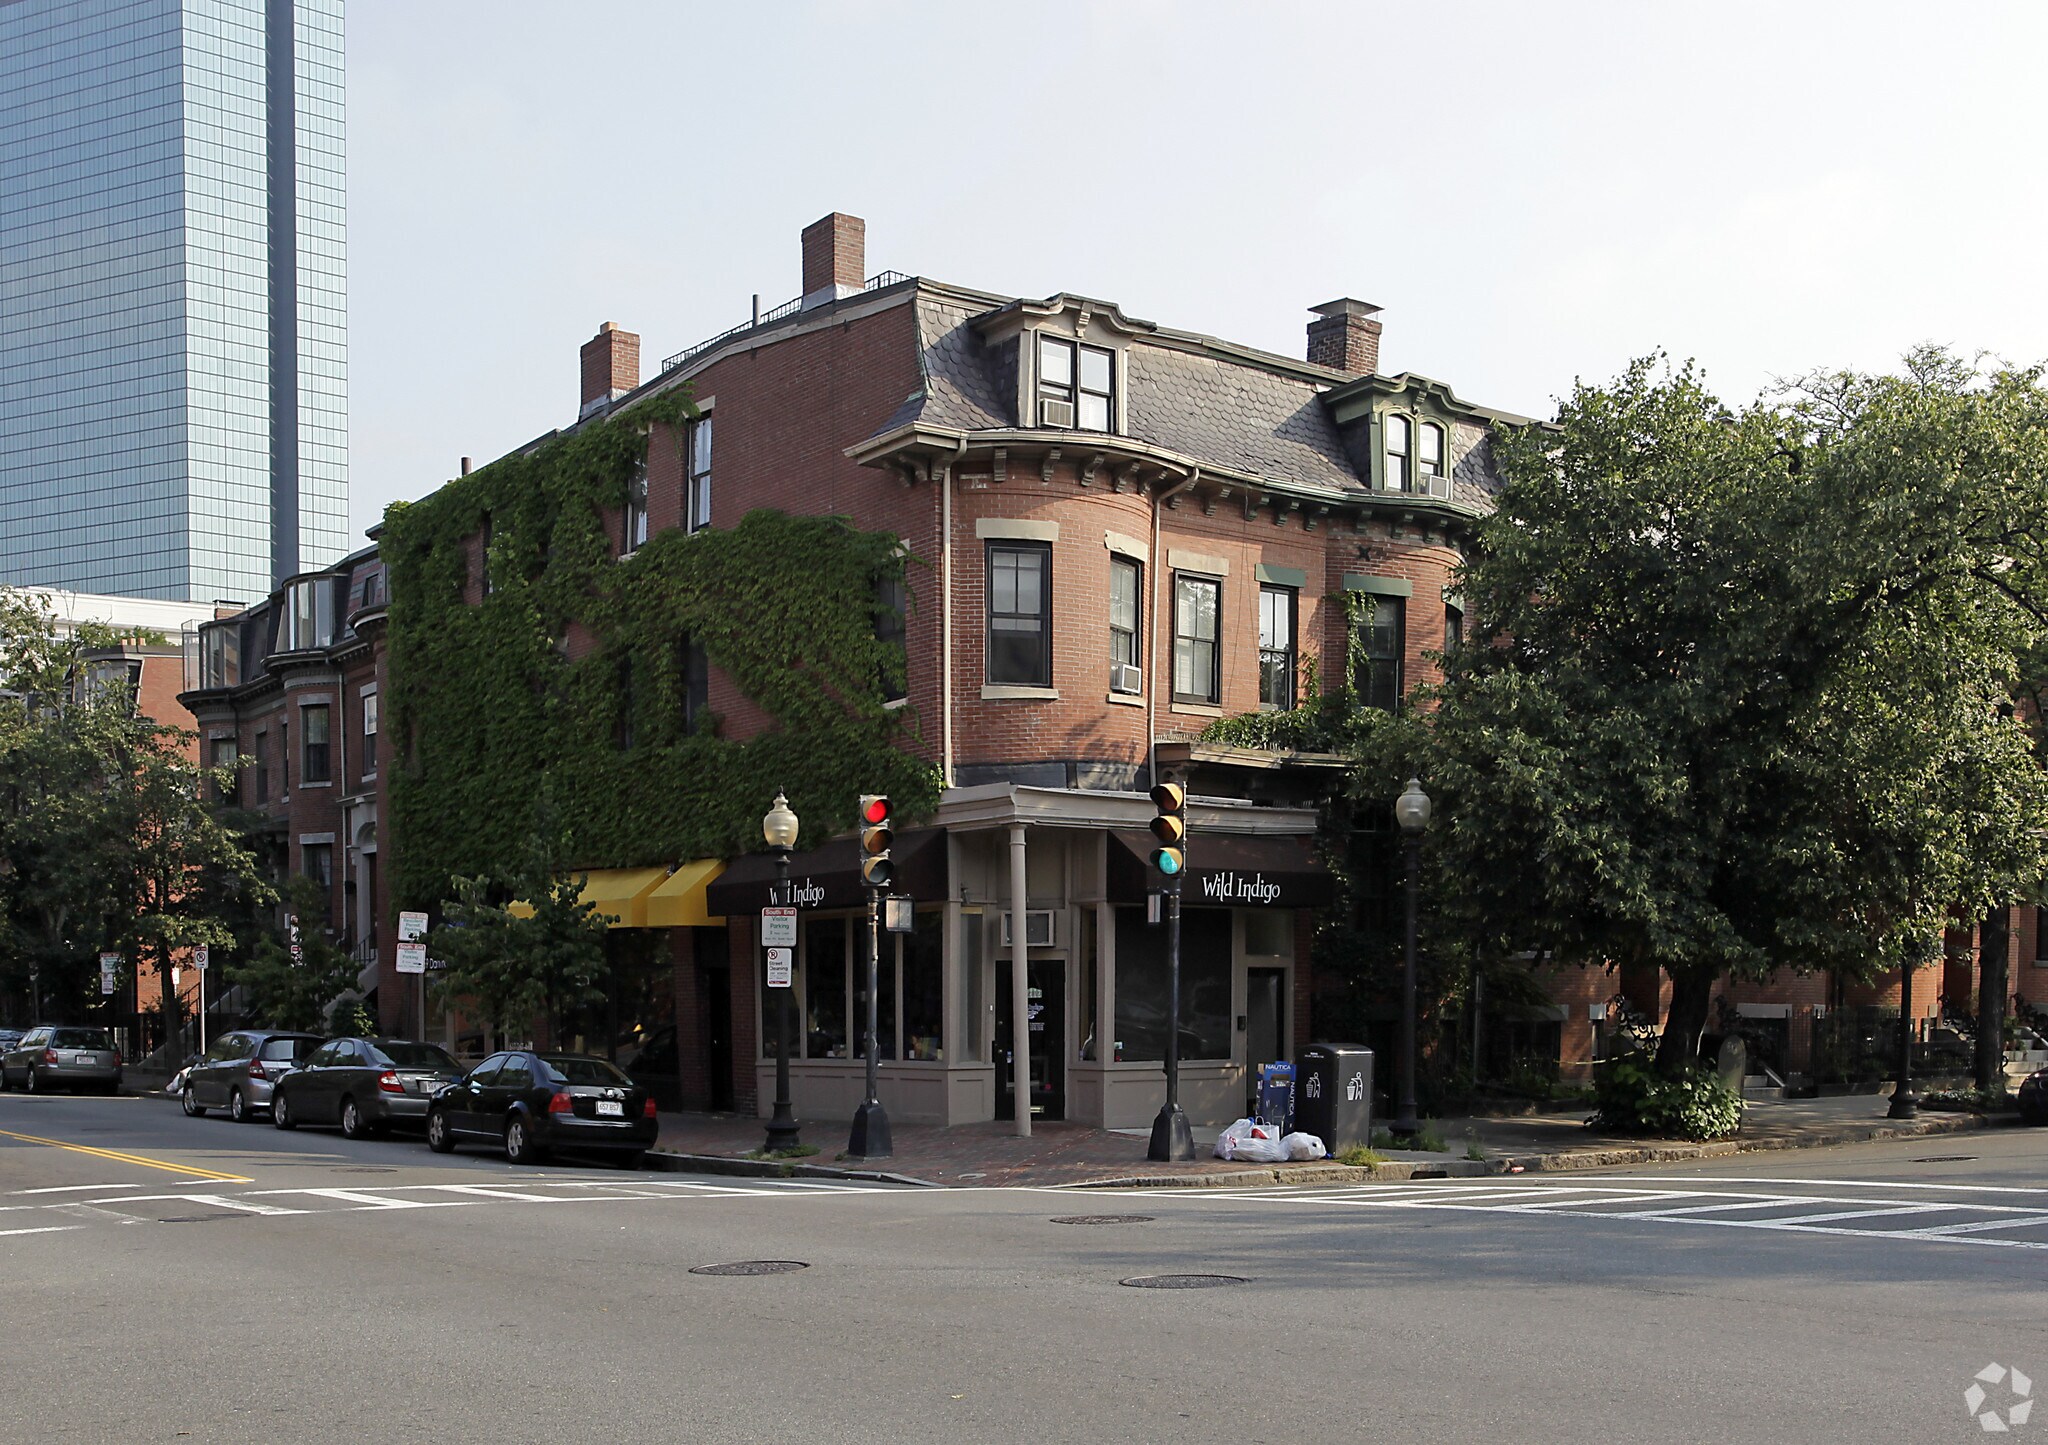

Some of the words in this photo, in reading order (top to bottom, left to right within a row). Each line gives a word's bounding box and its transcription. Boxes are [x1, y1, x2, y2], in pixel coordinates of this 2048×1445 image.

[793, 877, 825, 907] Indigo
[1202, 872, 1233, 902] Wild
[1236, 872, 1280, 903] Indigo
